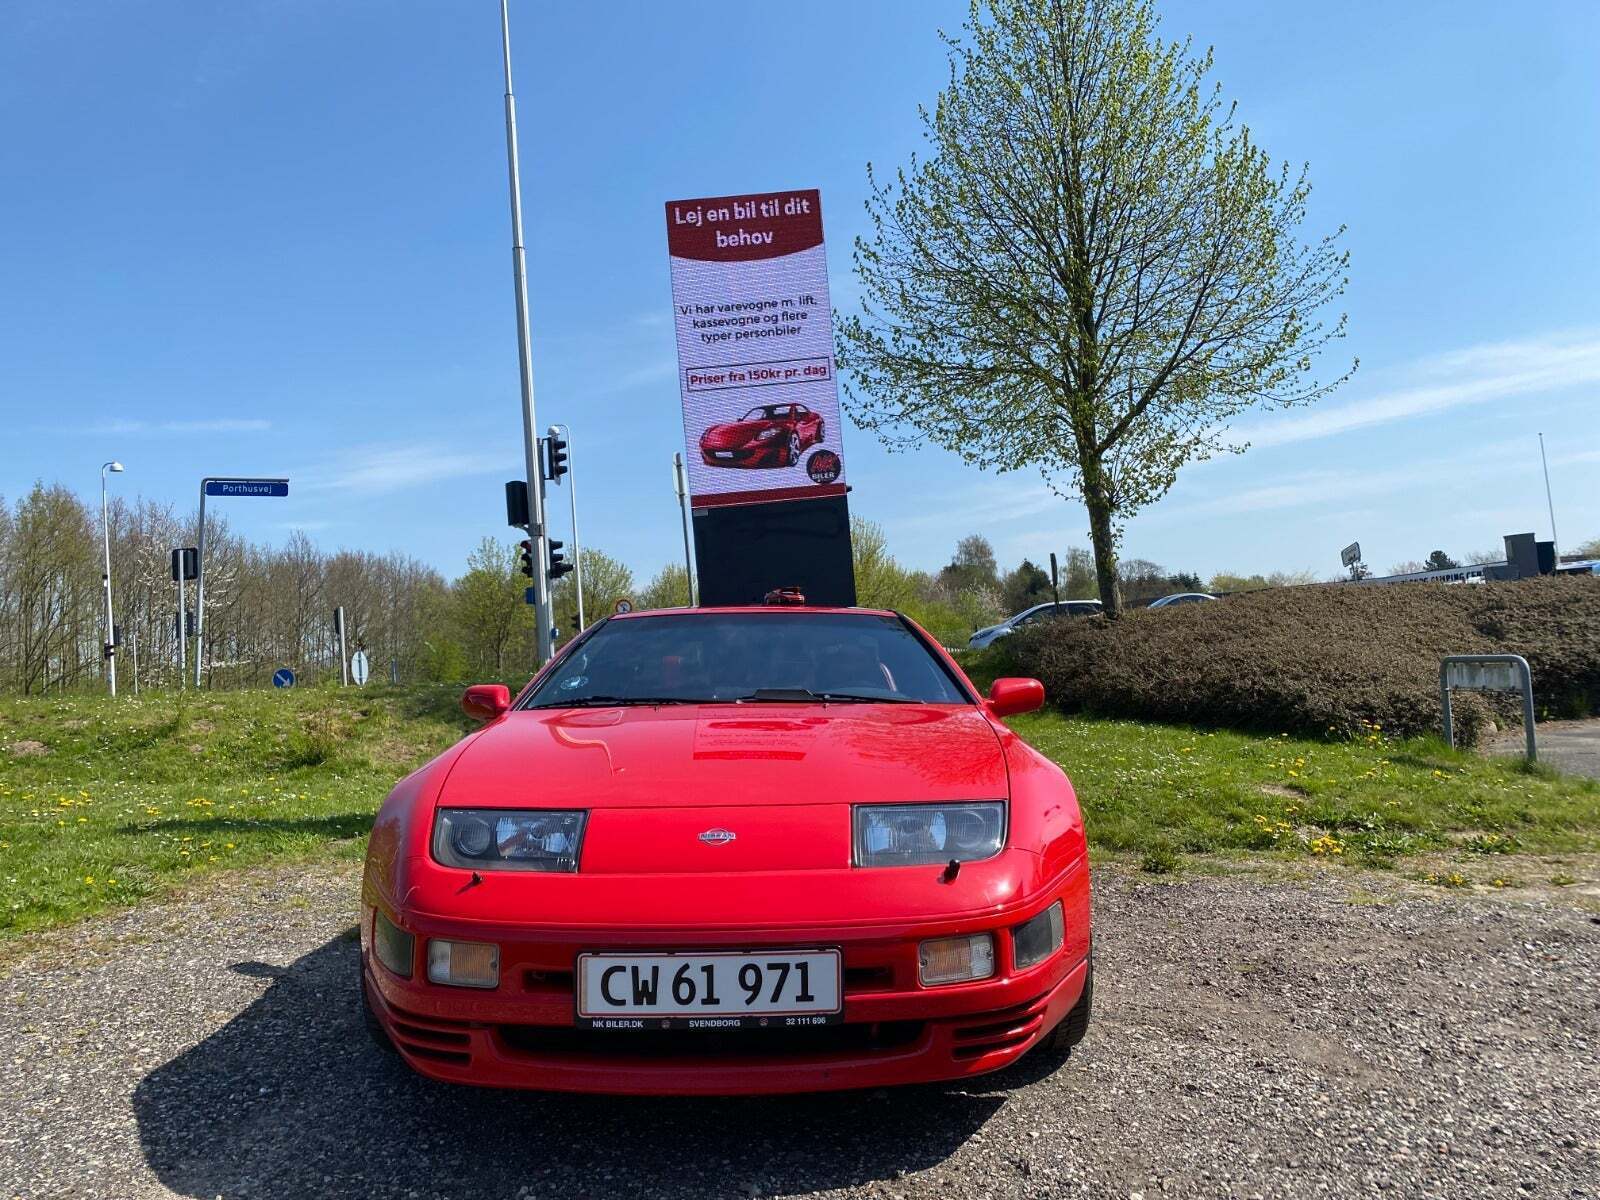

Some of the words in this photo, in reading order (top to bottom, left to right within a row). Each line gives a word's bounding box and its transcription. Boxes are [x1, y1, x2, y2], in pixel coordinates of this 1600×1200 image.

[674, 206, 702, 227] Lej
[706, 206, 730, 223] en
[733, 201, 756, 220] bil
[759, 199, 780, 218] til
[784, 197, 810, 215] dit
[715, 229, 773, 248] behov
[680, 305, 692, 315] Vi
[695, 303, 714, 315] har
[717, 300, 778, 313] varevogne
[781, 298, 794, 308] m.
[692, 313, 761, 330] kassevogne
[763, 312, 779, 325] og
[781, 309, 808, 321] flere
[701, 330, 732, 344] typer
[735, 325, 802, 340] personbiler
[689, 372, 724, 386] Priser
[728, 370, 746, 382] fra
[749, 367, 781, 381] 150kr
[784, 367, 801, 378] pr.
[803, 362, 828, 378] dag
[222, 484, 272, 494] Porthusvej
[600, 964, 660, 1006] CW
[671, 962, 721, 1006] 61
[737, 961, 815, 1005] 971
[592, 1020, 604, 1029] NK
[606, 1020, 644, 1029] BILER.DK
[689, 1019, 741, 1028] SVENDBORG
[785, 1018, 796, 1026] 32
[797, 1017, 810, 1025] 111
